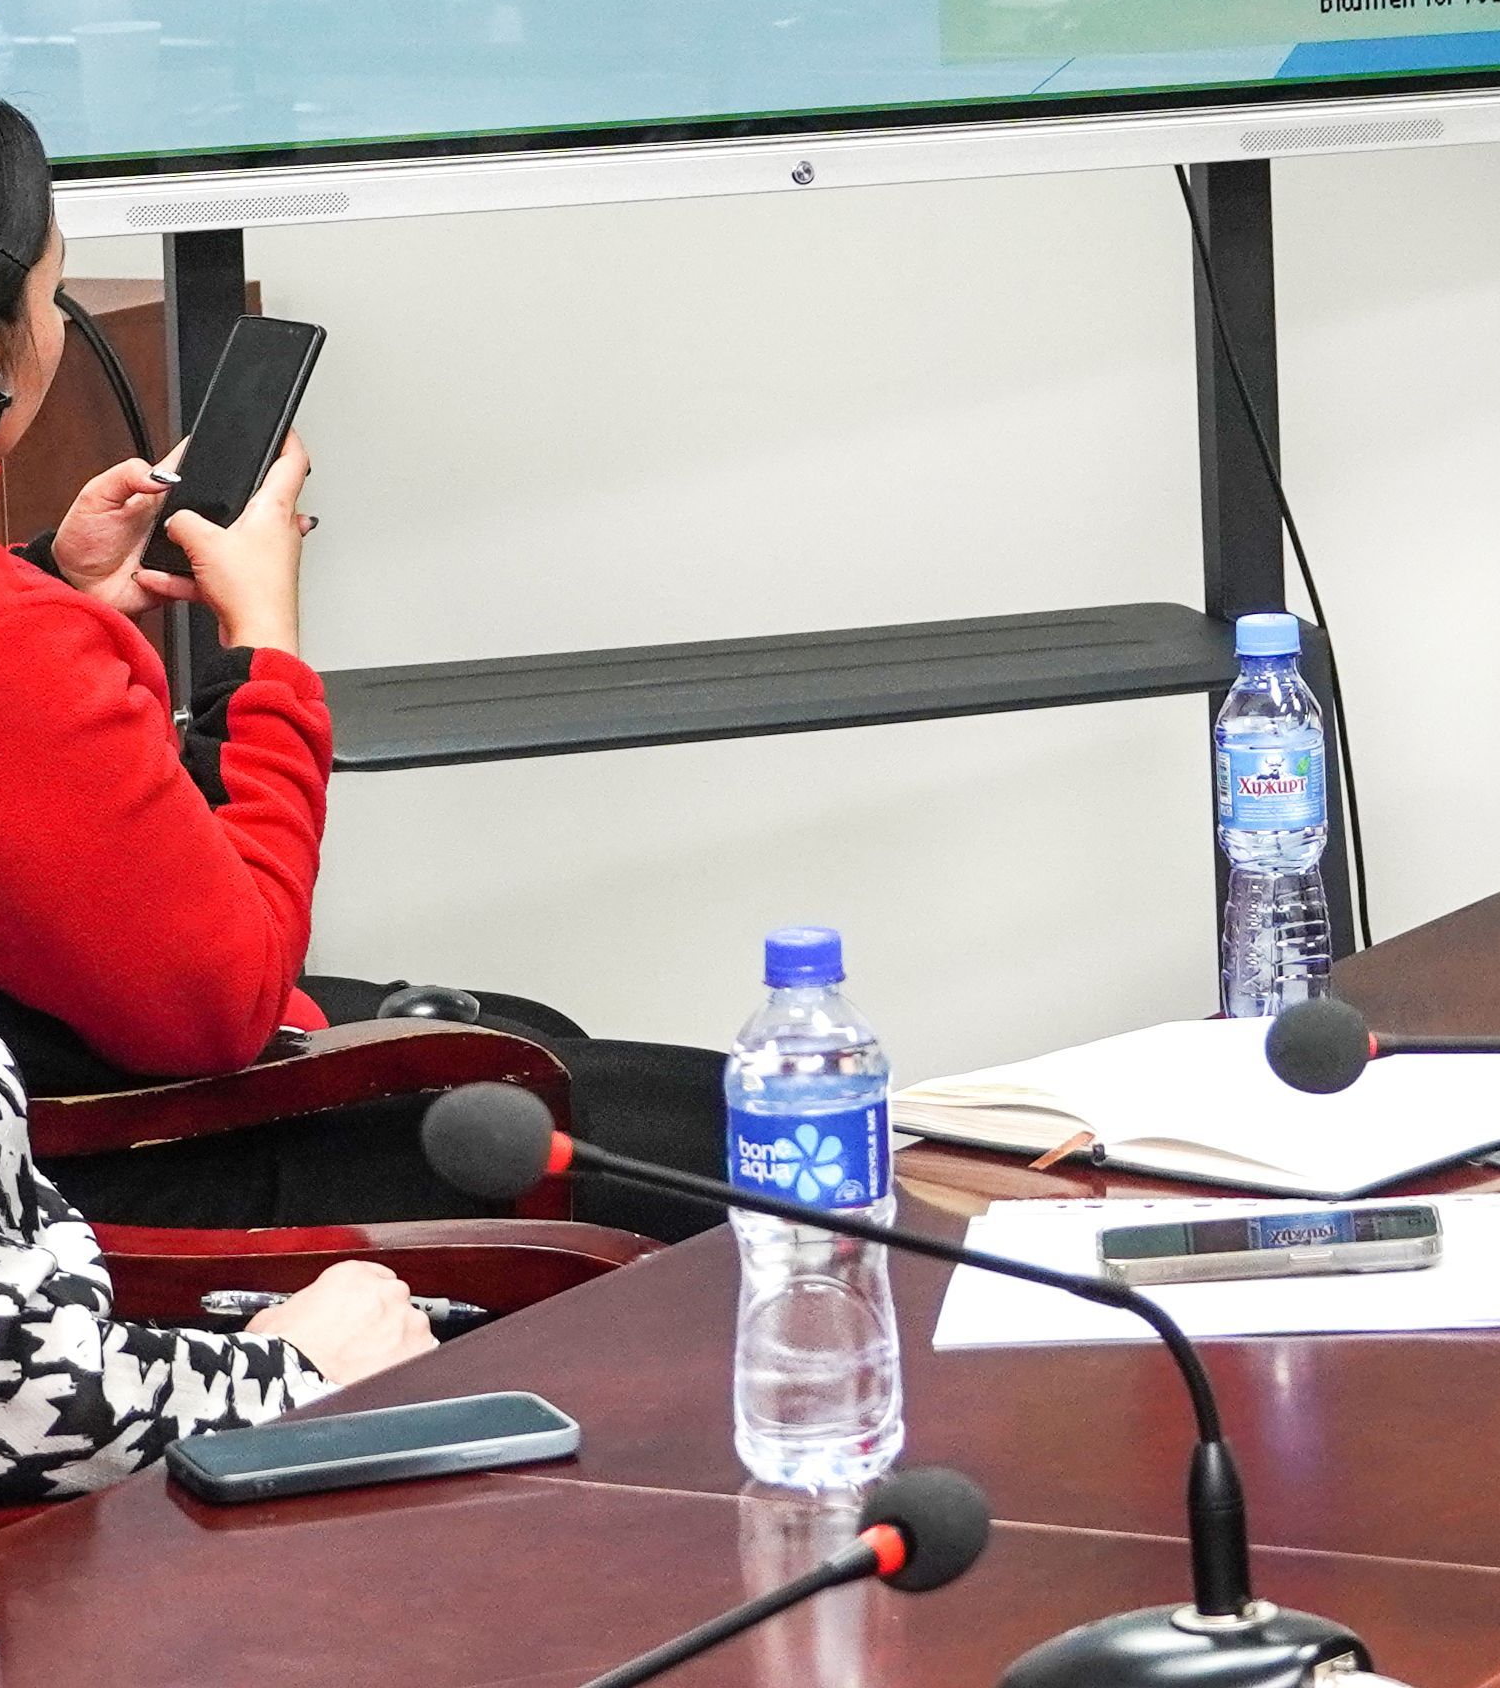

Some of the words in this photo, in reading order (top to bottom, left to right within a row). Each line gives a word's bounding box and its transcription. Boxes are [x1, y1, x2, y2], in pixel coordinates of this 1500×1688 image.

[1238, 776, 1307, 797] Хужирт
[738, 1134, 777, 1162] bon
[739, 1158, 790, 1185] aqua
